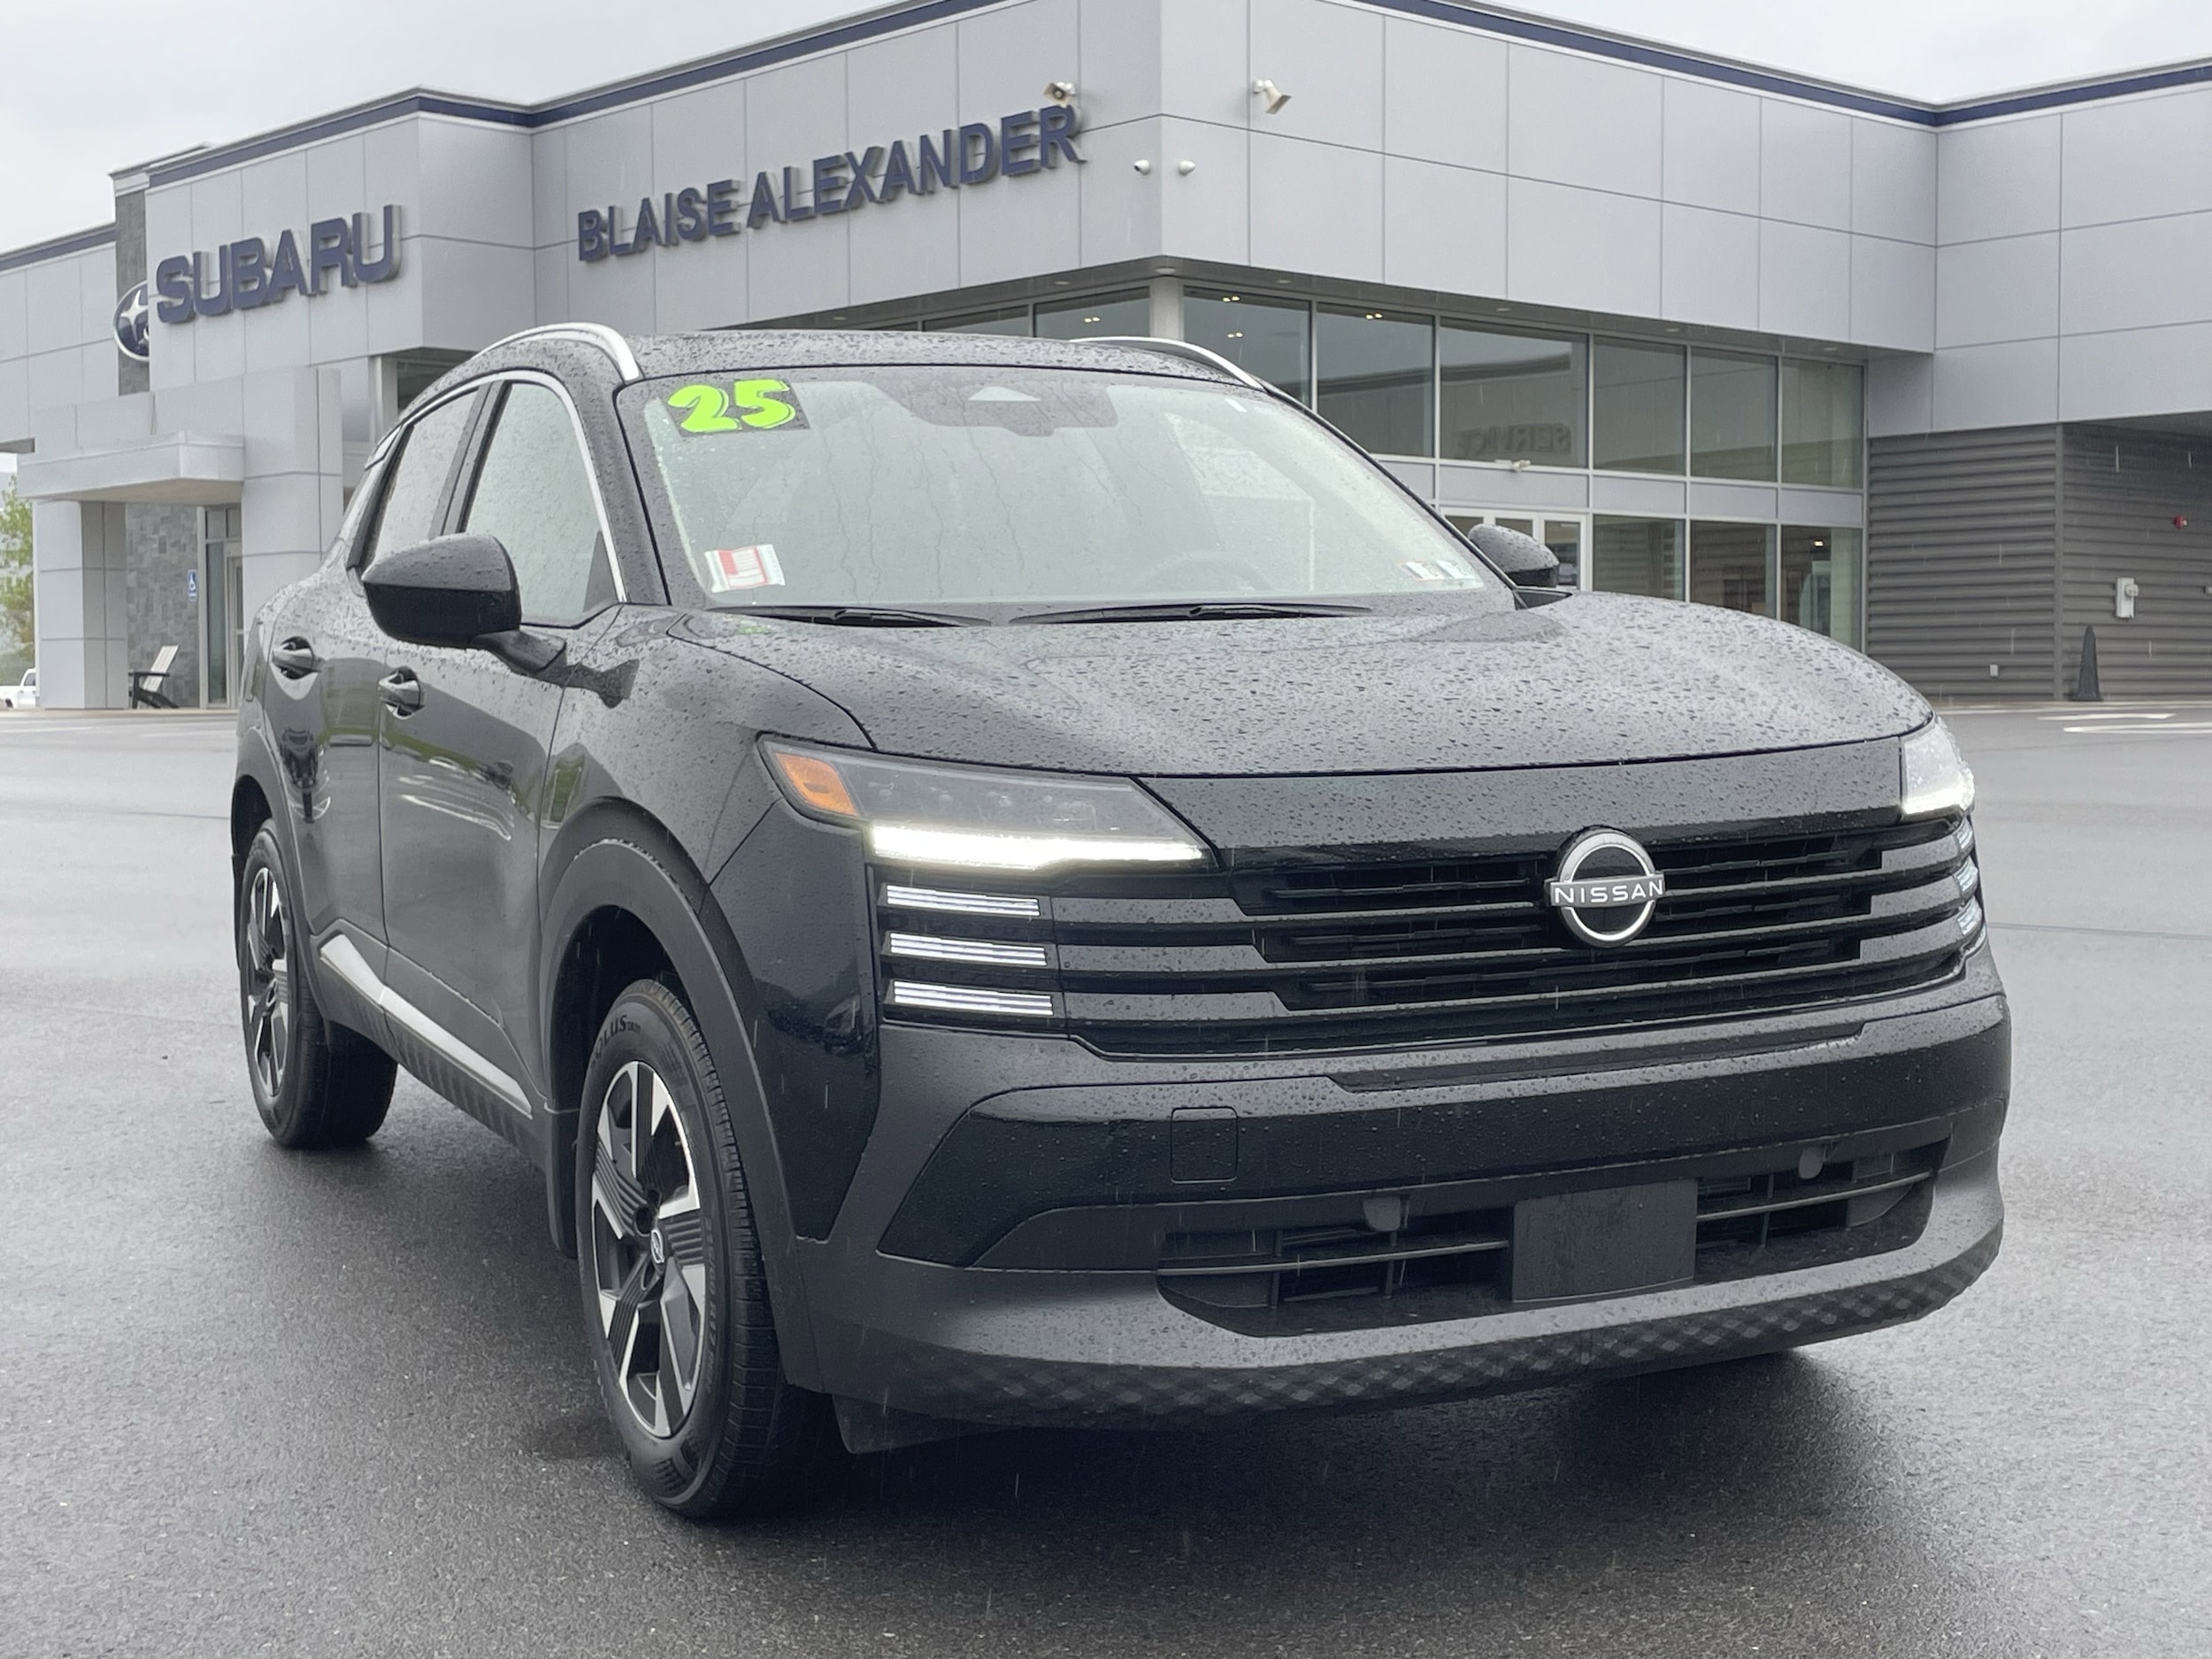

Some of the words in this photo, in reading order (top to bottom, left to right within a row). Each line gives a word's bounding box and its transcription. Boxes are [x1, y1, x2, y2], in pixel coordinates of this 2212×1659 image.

[579, 179, 740, 262] BLAISE
[746, 104, 1087, 229] ALEXANDER
[156, 204, 401, 325] SUBARU
[667, 379, 796, 433] 25
[1554, 879, 1663, 903] NISSAN
